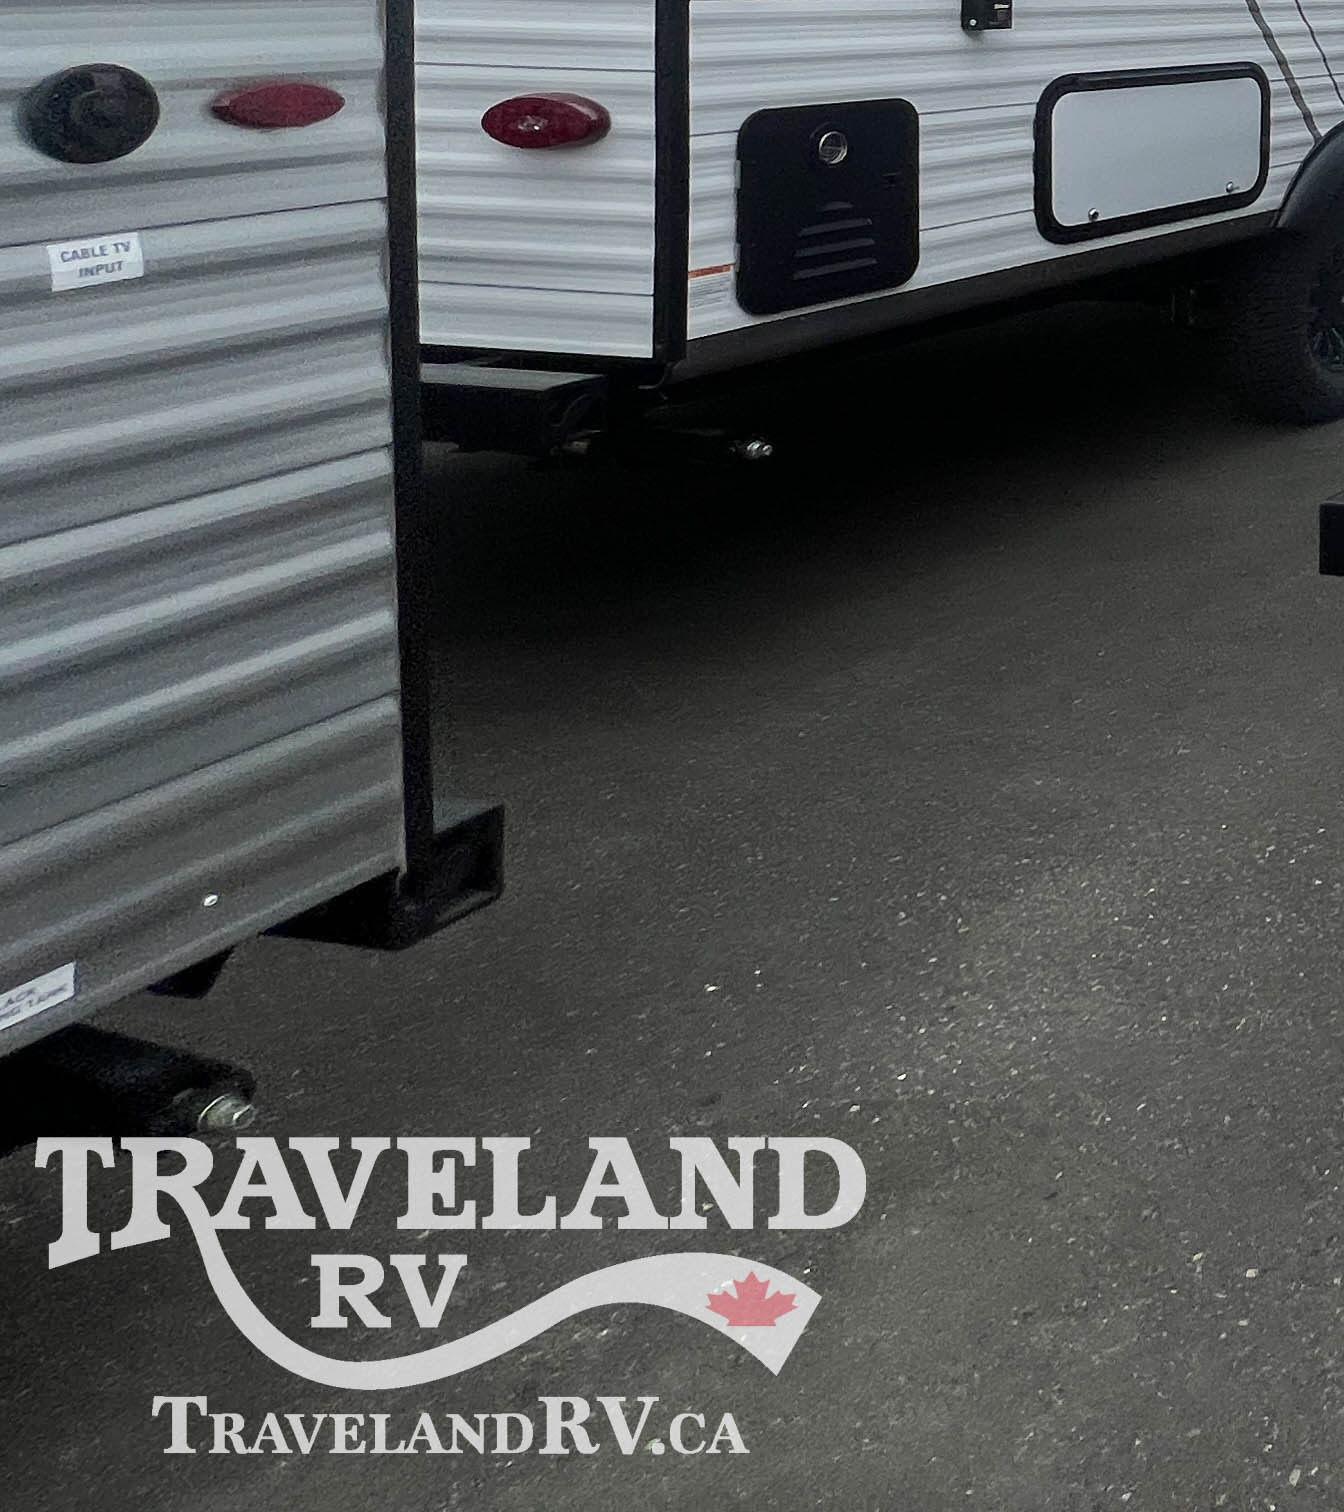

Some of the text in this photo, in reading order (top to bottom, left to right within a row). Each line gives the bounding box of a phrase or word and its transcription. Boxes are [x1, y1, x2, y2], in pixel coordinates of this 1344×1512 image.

[60, 241, 131, 263] CABLE TV
[79, 260, 123, 278] INPUT
